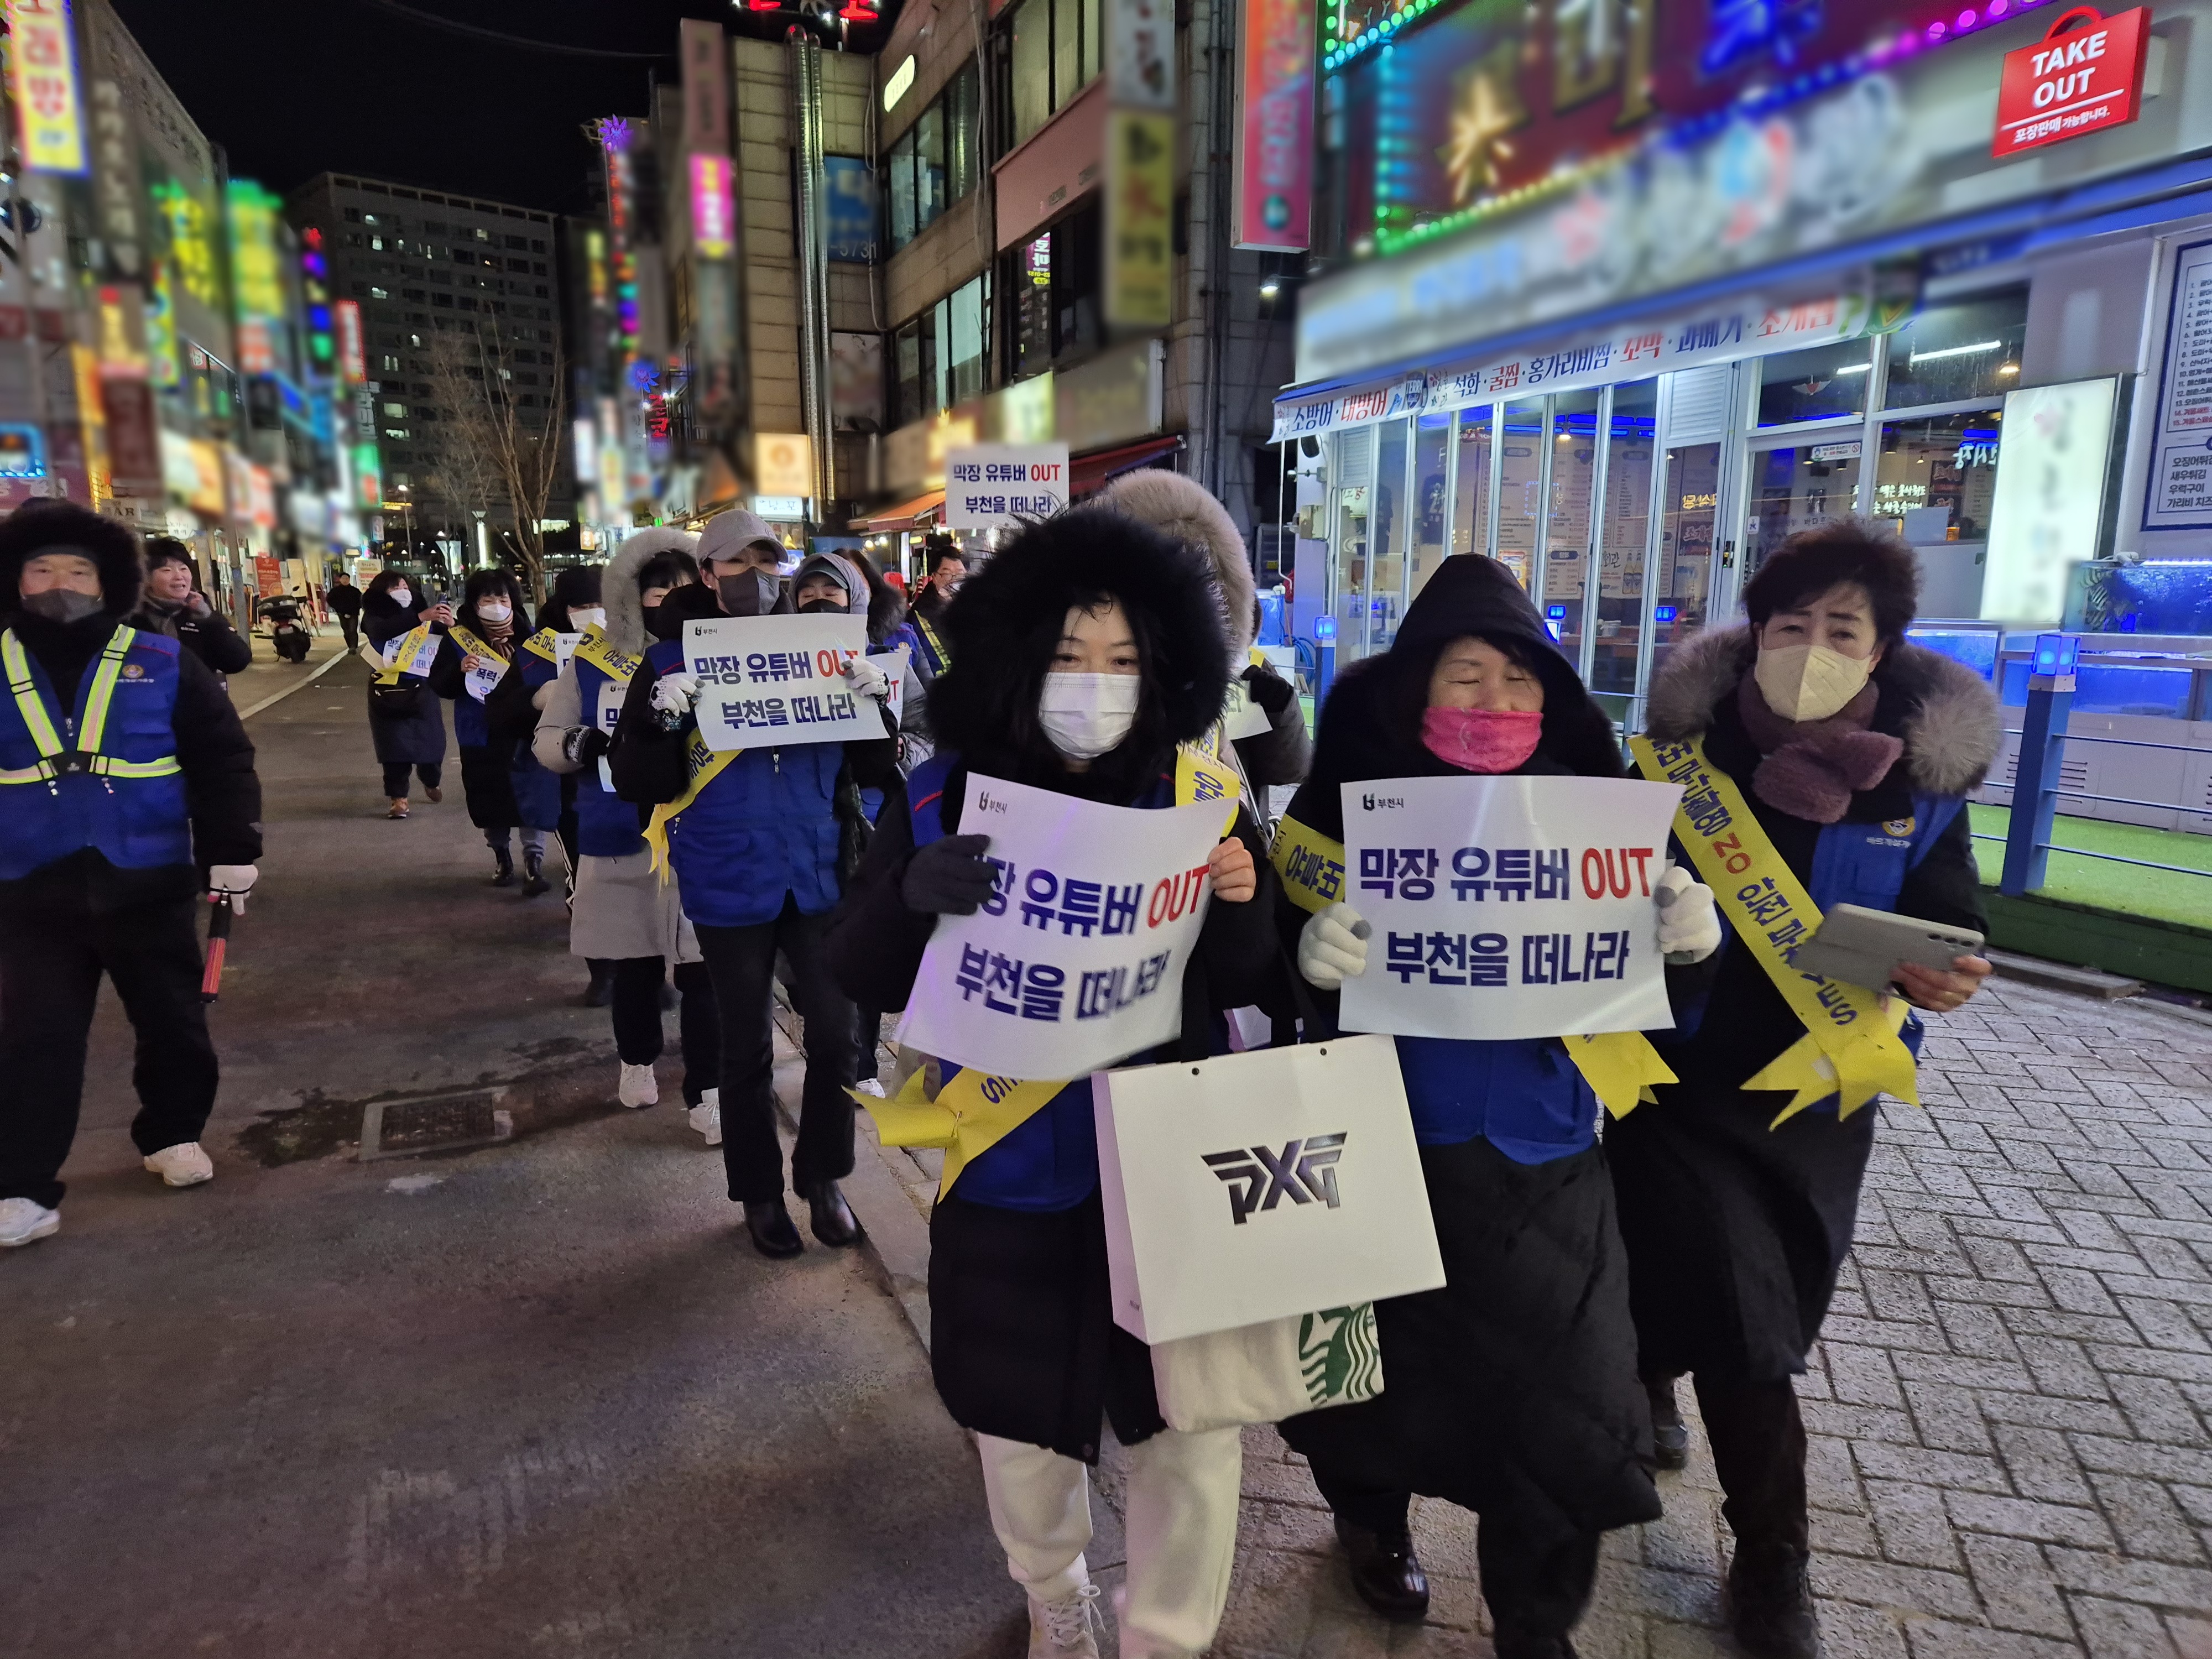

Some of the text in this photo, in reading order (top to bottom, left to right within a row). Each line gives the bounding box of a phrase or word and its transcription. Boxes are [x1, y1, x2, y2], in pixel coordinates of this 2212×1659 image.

[2031, 30, 2109, 79] TAKE
[2032, 67, 2096, 108] OUT
[2013, 116, 2062, 144] 포장판매
[1453, 371, 1481, 397] 석화
[1489, 362, 1520, 392] 굴찜
[1528, 341, 1613, 384] 홍가리비찜
[1292, 399, 1334, 432] 소방어
[1340, 388, 1387, 422] 대방어
[953, 464, 1061, 482] 막장 유튜버 OUT
[2168, 483, 2205, 494] 우럭구이
[2170, 469, 2206, 481] 새우튀김
[966, 496, 1052, 514] 부천을 떠나라
[2167, 498, 2194, 508] 가리비
[693, 655, 741, 685] 막장
[746, 651, 813, 684] 유튜버
[721, 693, 857, 729] 부천을 떠나라
[1377, 797, 1405, 809] 부천시
[1359, 847, 1655, 902] 막장 유튜버 OUT
[1712, 832, 1752, 875] NO
[1736, 876, 1794, 926] 안전
[974, 854, 1212, 938] 장 유튜버 OUT
[1386, 930, 1631, 988] 부천을 떠나라
[955, 941, 1171, 1023] 부천을 떠나라
